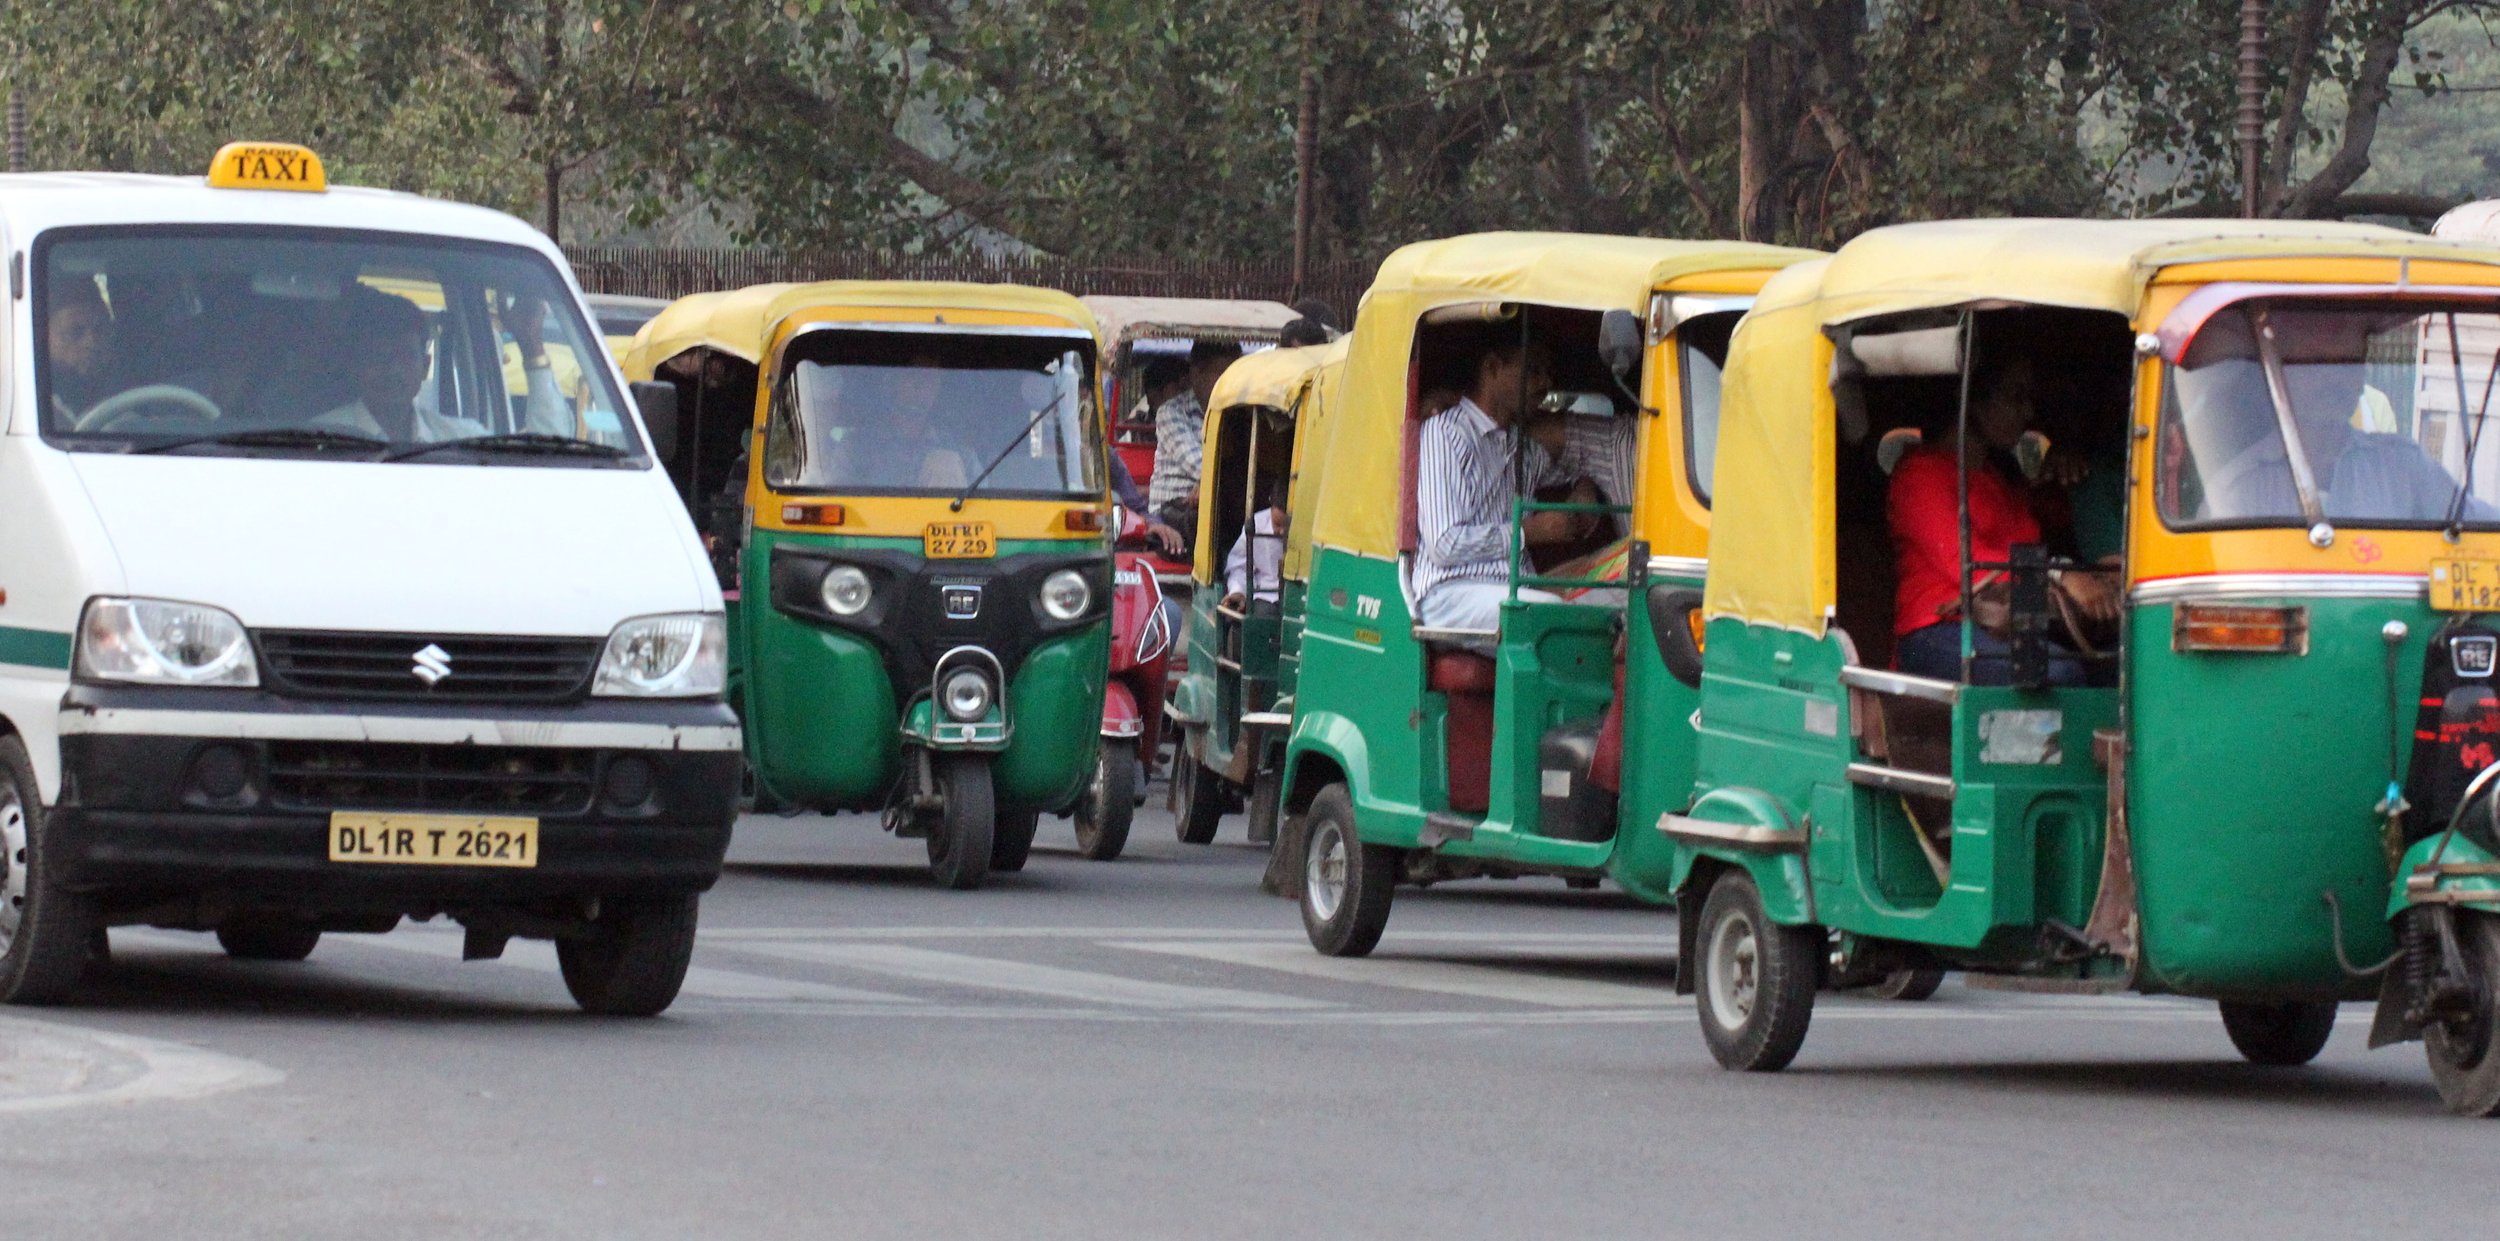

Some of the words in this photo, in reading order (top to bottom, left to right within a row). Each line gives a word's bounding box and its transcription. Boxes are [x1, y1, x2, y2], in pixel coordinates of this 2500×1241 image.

[232, 155, 309, 181] TAXI
[1356, 594, 1381, 620] TVS
[338, 827, 414, 855] DL1R
[428, 830, 446, 856] T
[455, 830, 527, 859] 2621
